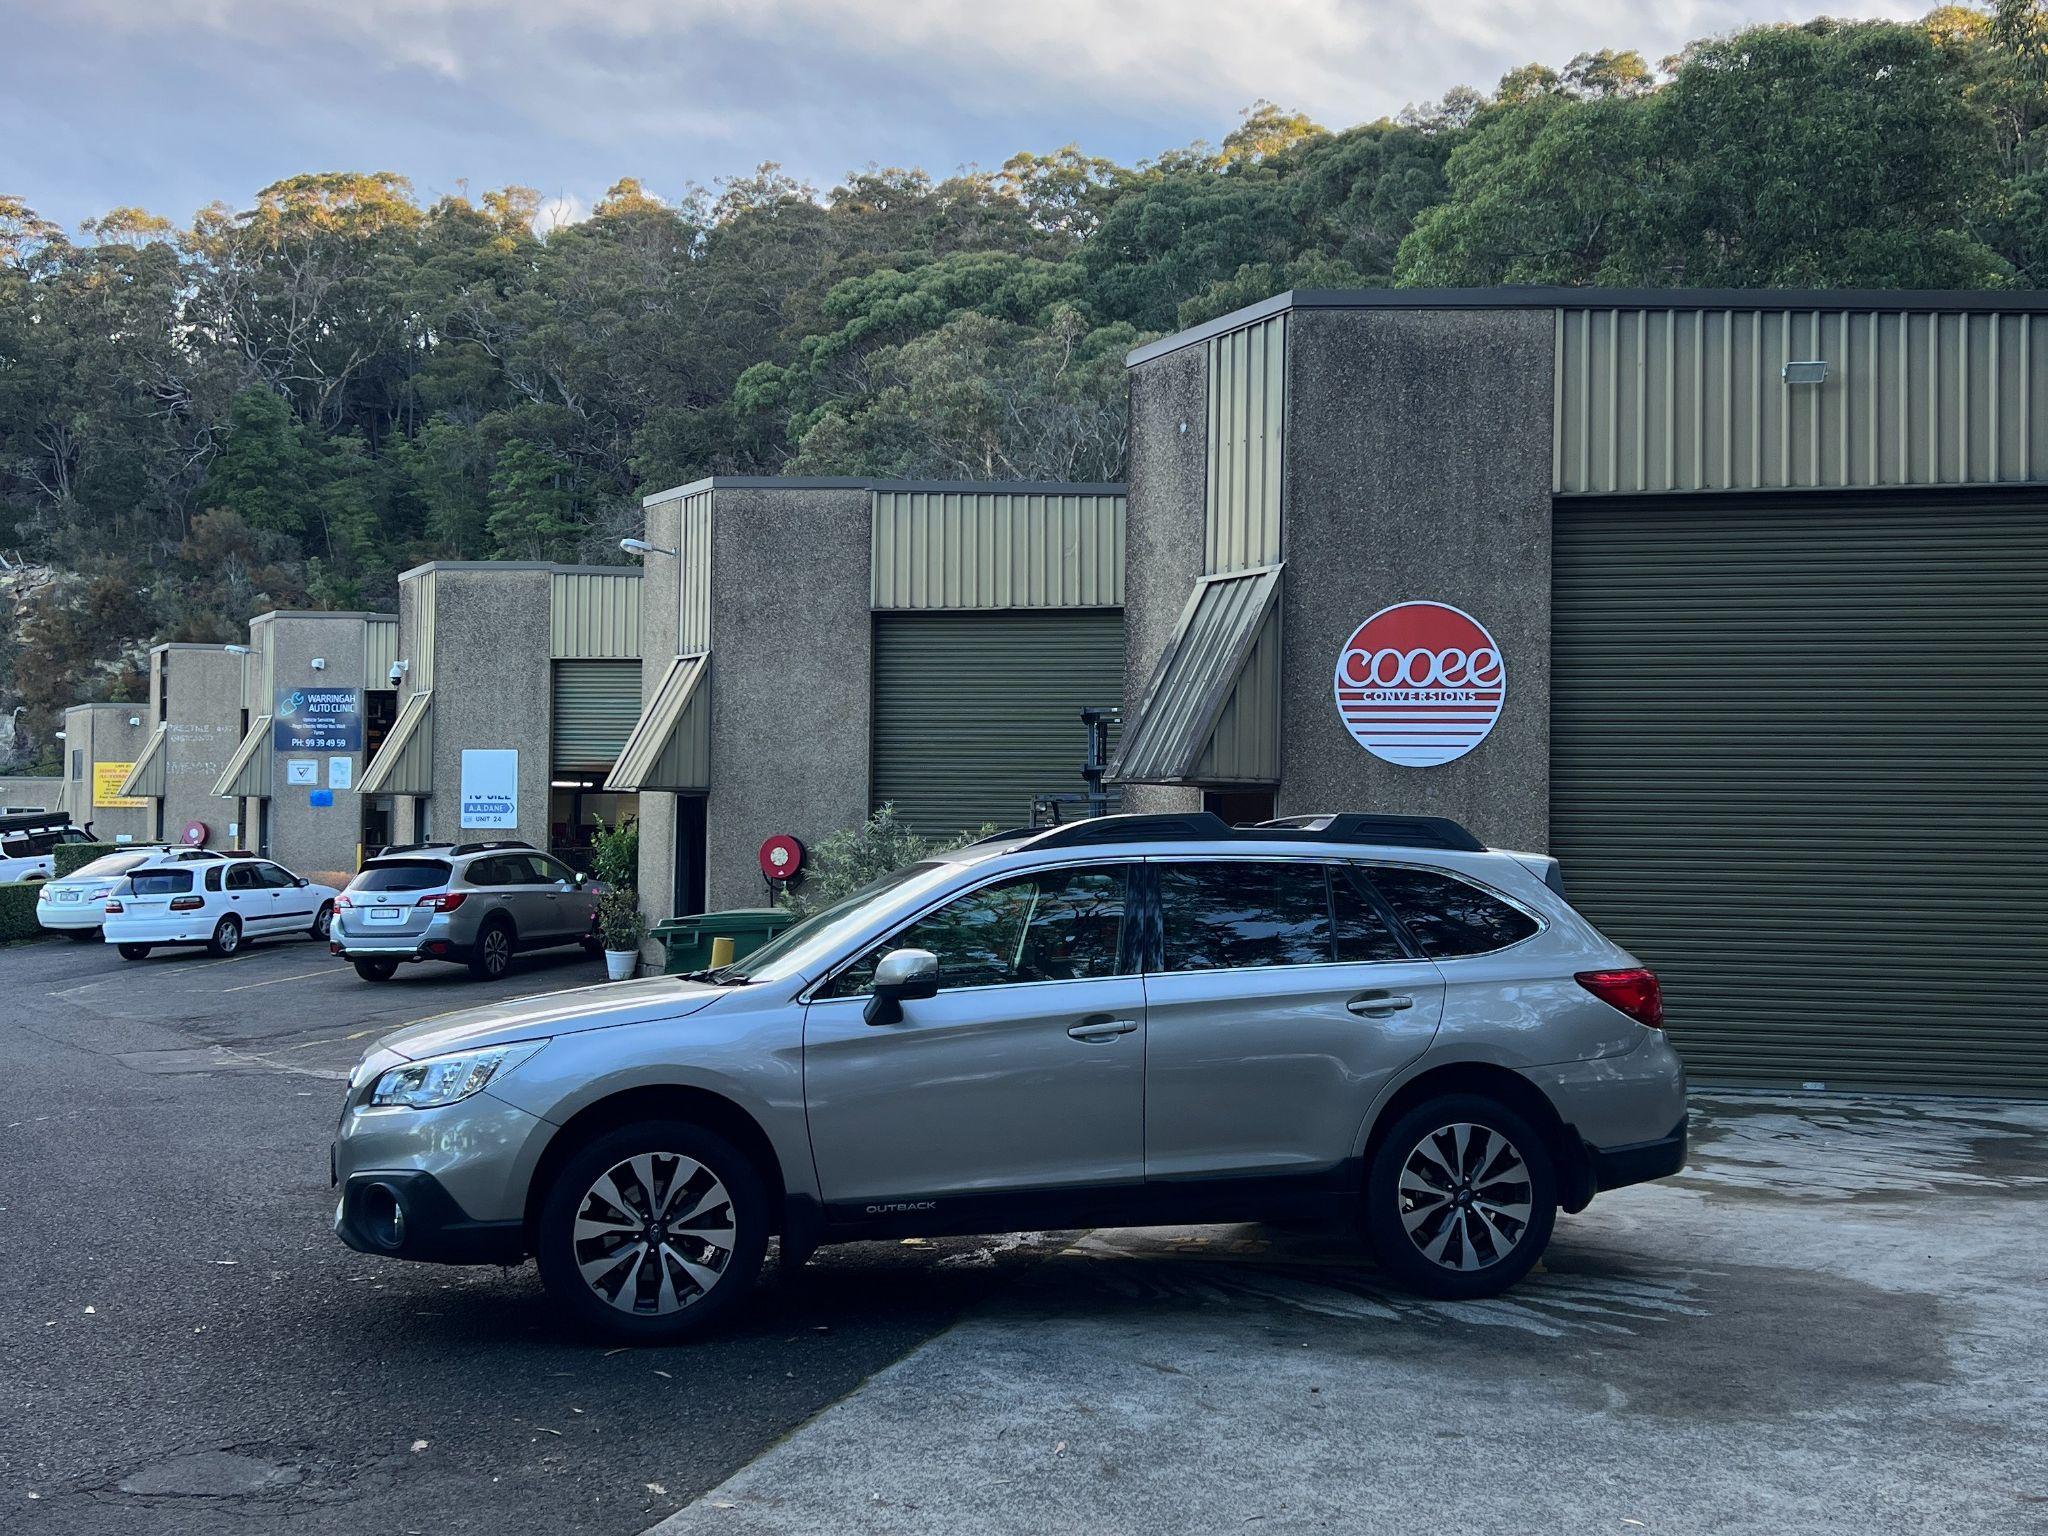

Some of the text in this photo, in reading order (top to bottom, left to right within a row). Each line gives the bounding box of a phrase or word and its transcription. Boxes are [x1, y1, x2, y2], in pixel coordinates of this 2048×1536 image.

[1339, 647, 1502, 688] cooee
[307, 694, 356, 703] WARRINGAH
[1362, 691, 1476, 701] CONVERSIONS
[309, 703, 355, 713] AUTO CLINIC
[291, 738, 346, 747] PH: 99 39 49 59
[866, 1201, 937, 1213] OUTBACK
